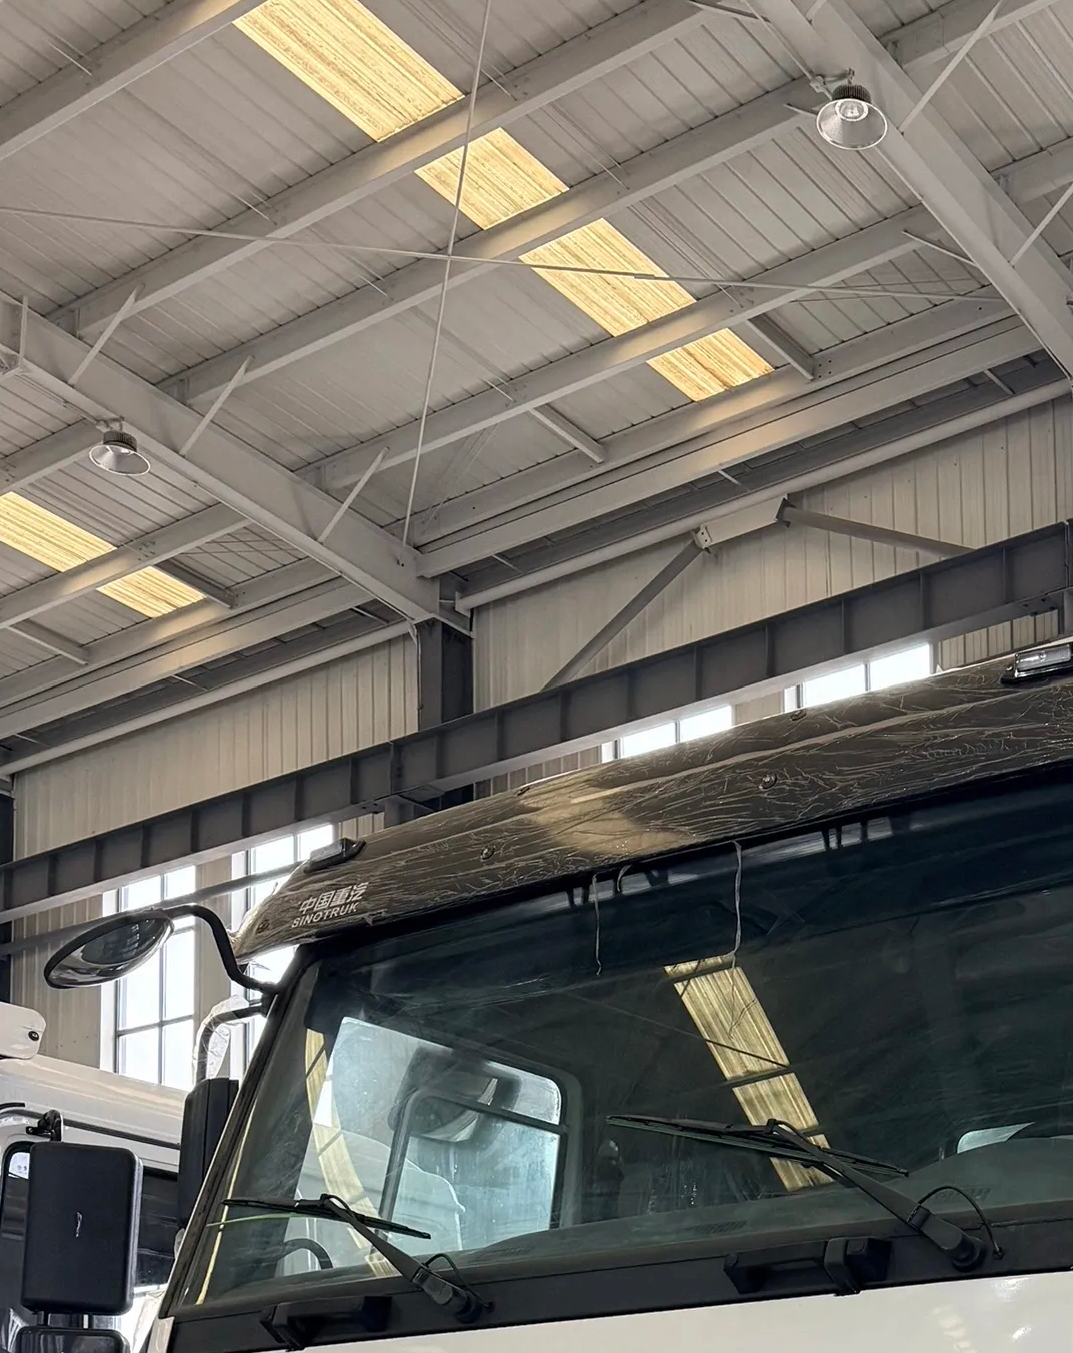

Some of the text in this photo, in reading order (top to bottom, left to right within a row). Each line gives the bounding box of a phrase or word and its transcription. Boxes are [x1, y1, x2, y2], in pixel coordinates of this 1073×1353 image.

[299, 882, 369, 914] 中国重汽
[291, 902, 360, 928] SINOTRUK
